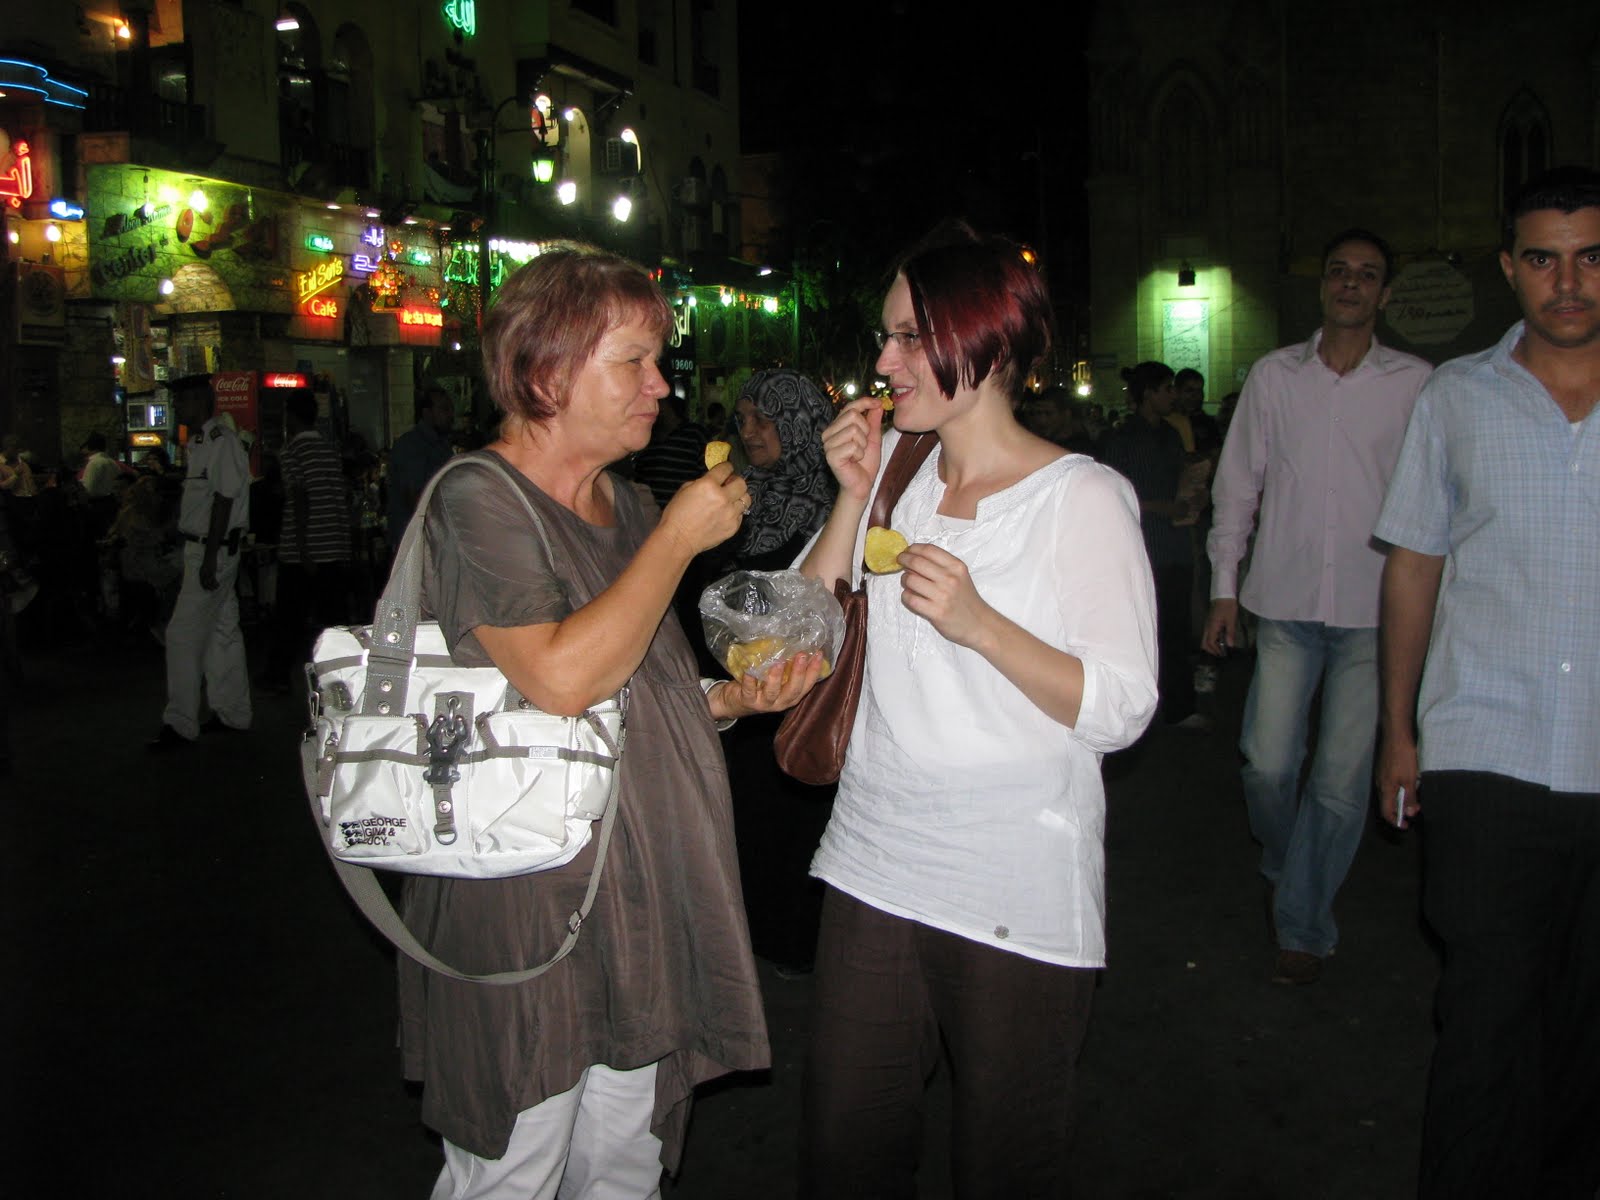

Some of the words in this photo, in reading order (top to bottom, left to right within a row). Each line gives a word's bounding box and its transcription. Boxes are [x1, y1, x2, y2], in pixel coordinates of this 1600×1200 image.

[311, 300, 337, 318] Café
[362, 818, 407, 827] GEORGE
[365, 828, 386, 837] GINA
[388, 828, 396, 836] &
